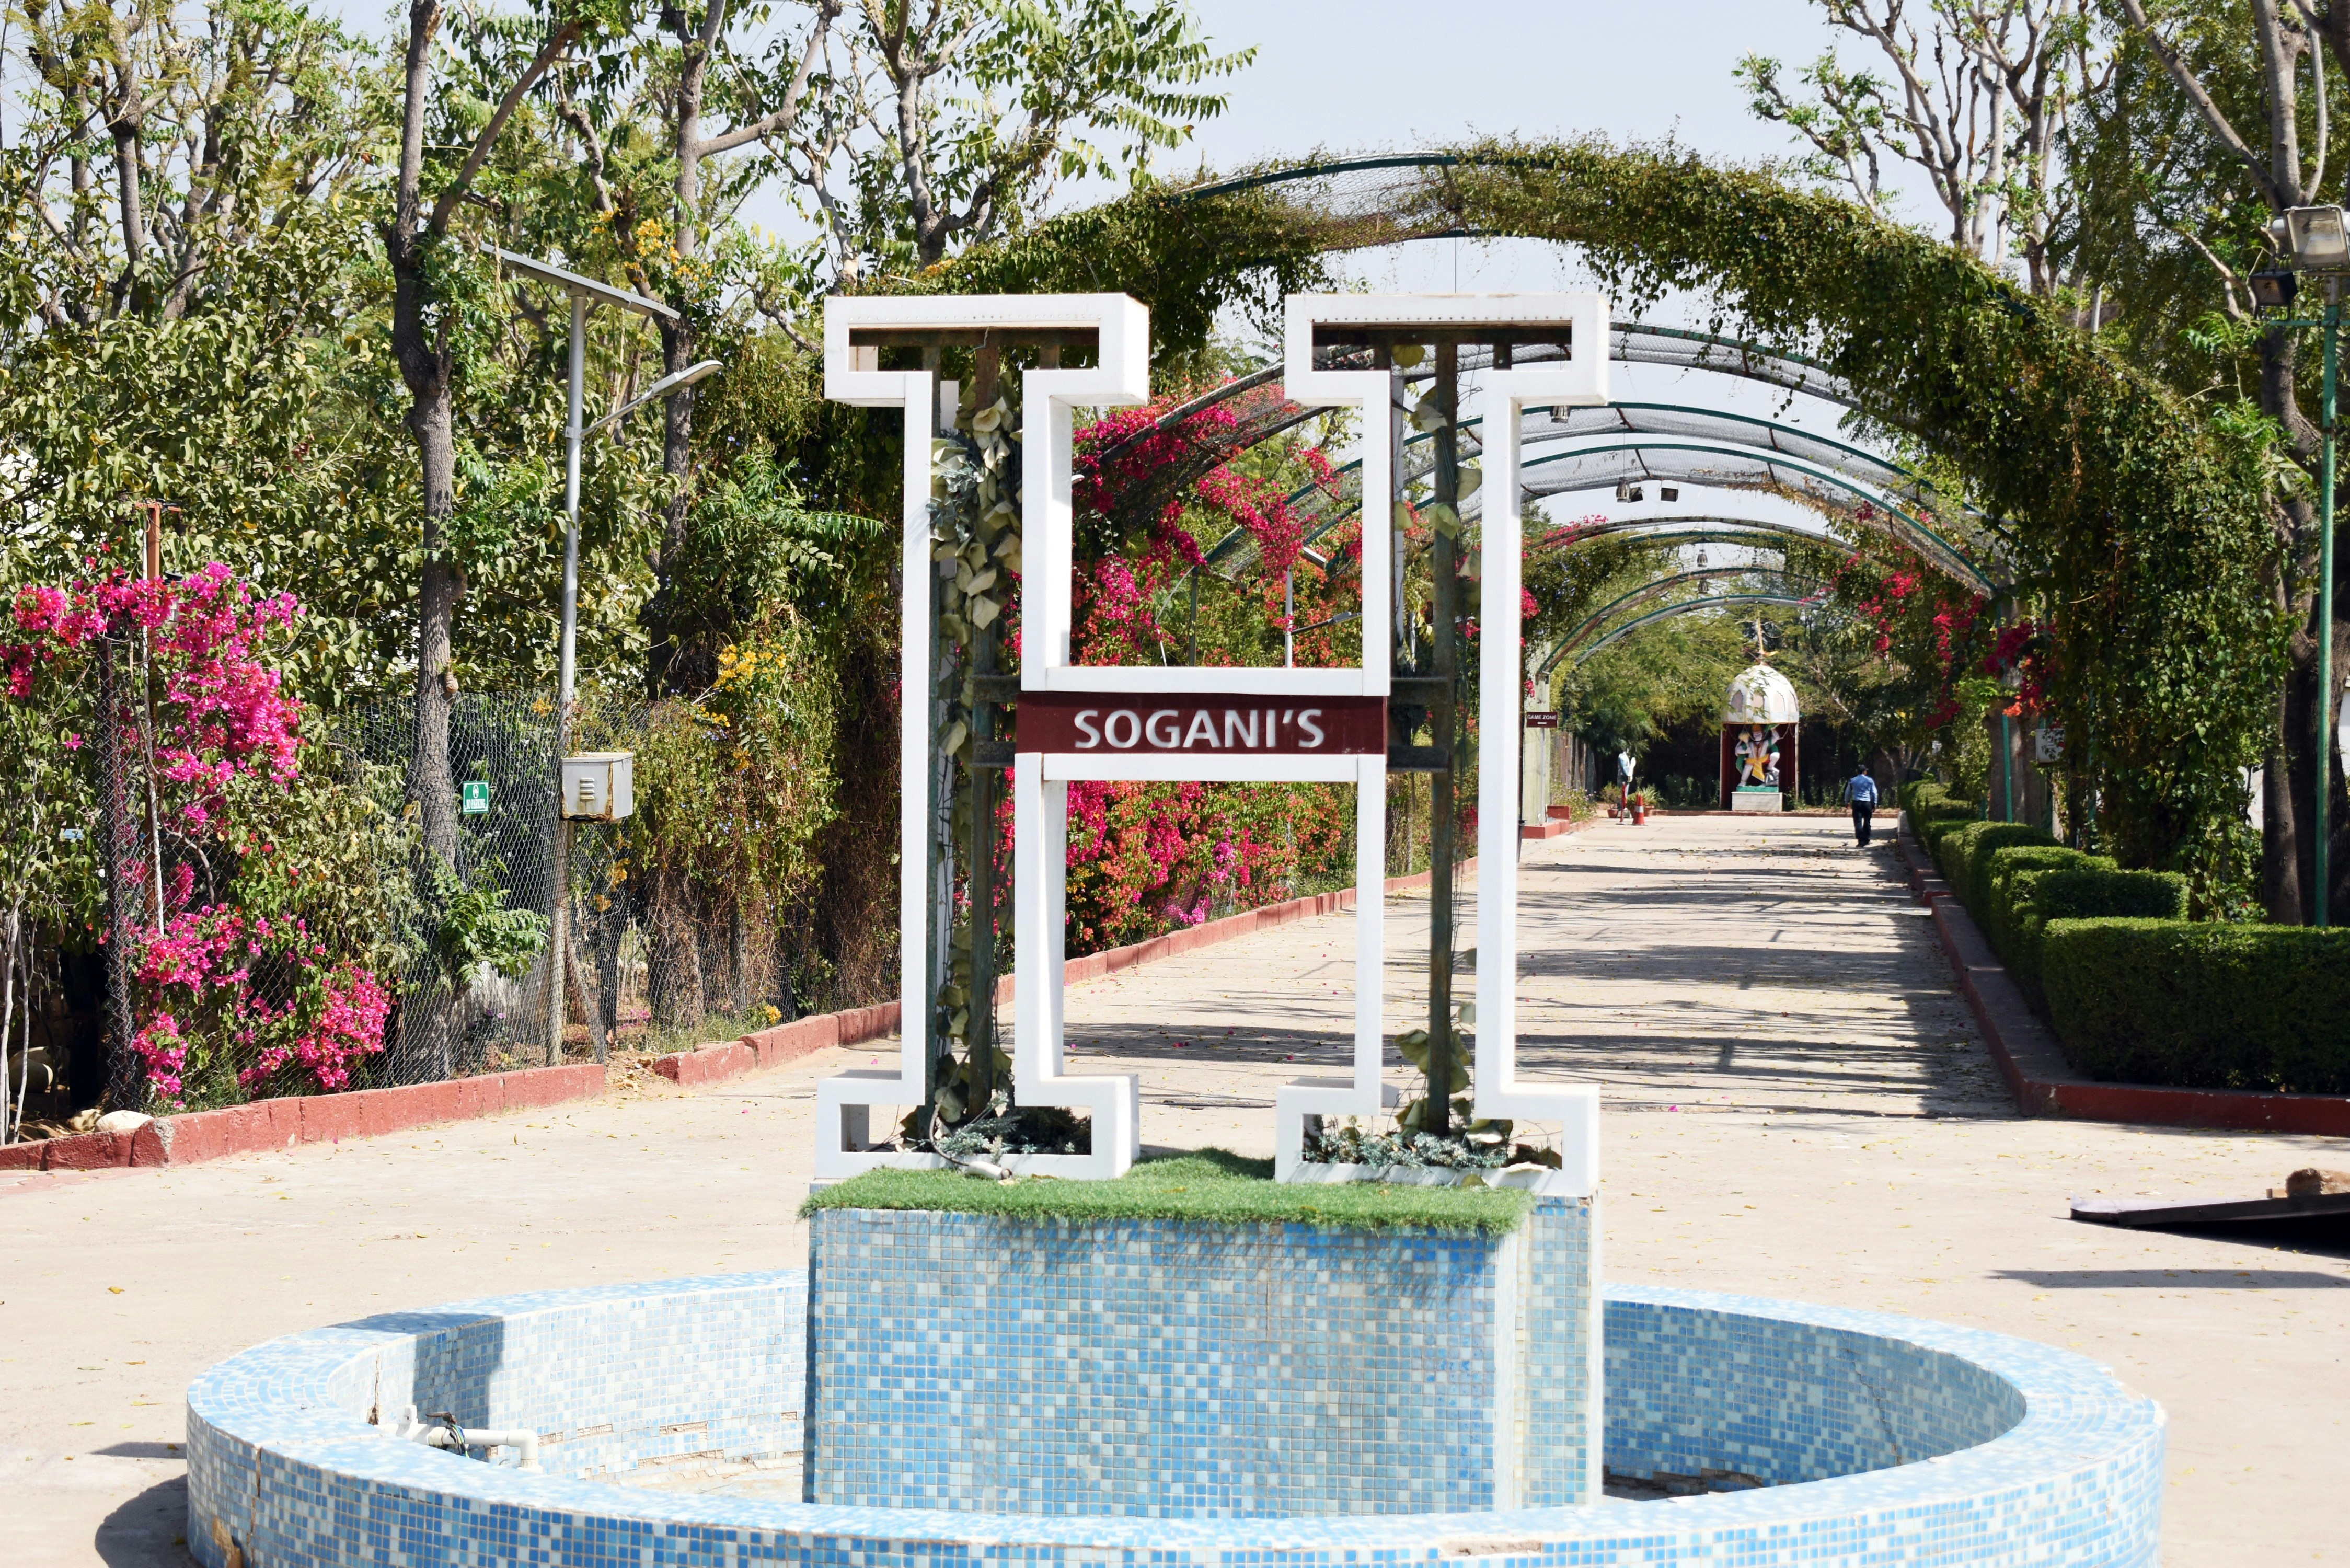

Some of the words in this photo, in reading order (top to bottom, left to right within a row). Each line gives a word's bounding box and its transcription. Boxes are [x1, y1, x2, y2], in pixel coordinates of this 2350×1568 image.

[1074, 709, 1325, 748] SOGANI'S
[466, 799, 471, 809] NO
[471, 798, 486, 809] PARKING
